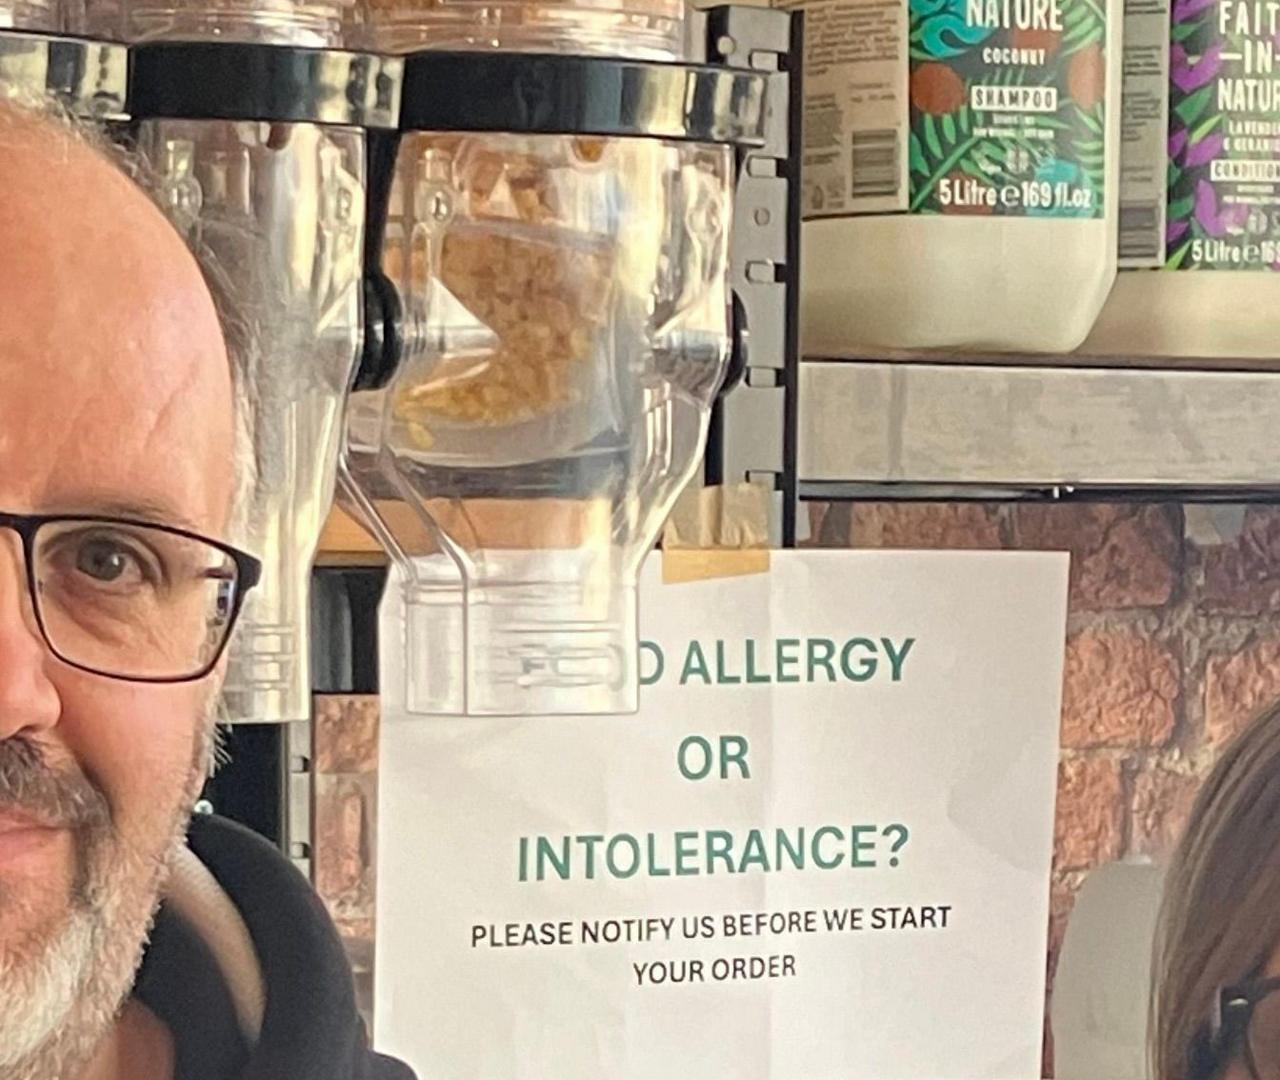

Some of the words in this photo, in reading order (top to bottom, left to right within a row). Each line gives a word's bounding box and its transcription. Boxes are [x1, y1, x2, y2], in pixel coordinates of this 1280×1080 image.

[966, 0, 1063, 31] NATURE
[982, 47, 1046, 65] COCONUT
[1244, 40, 1273, 74] IN
[975, 87, 1053, 108] SHAMPOO
[939, 179, 952, 205] 5
[954, 179, 997, 206] Litre
[1021, 181, 1052, 207] 169
[1191, 239, 1202, 262] 5
[1204, 239, 1239, 263] Litre
[679, 638, 916, 686] ALLERGY
[677, 735, 751, 781] OR
[518, 823, 909, 882] INTOLERANCE?
[471, 921, 574, 948] PLEASE
[581, 917, 675, 944] NOTIFY
[681, 915, 716, 940] US
[723, 911, 818, 938] BEFORE
[824, 908, 864, 933] WE
[870, 906, 953, 931] START
[632, 960, 705, 986] YOUR
[711, 955, 797, 982] ORDER
